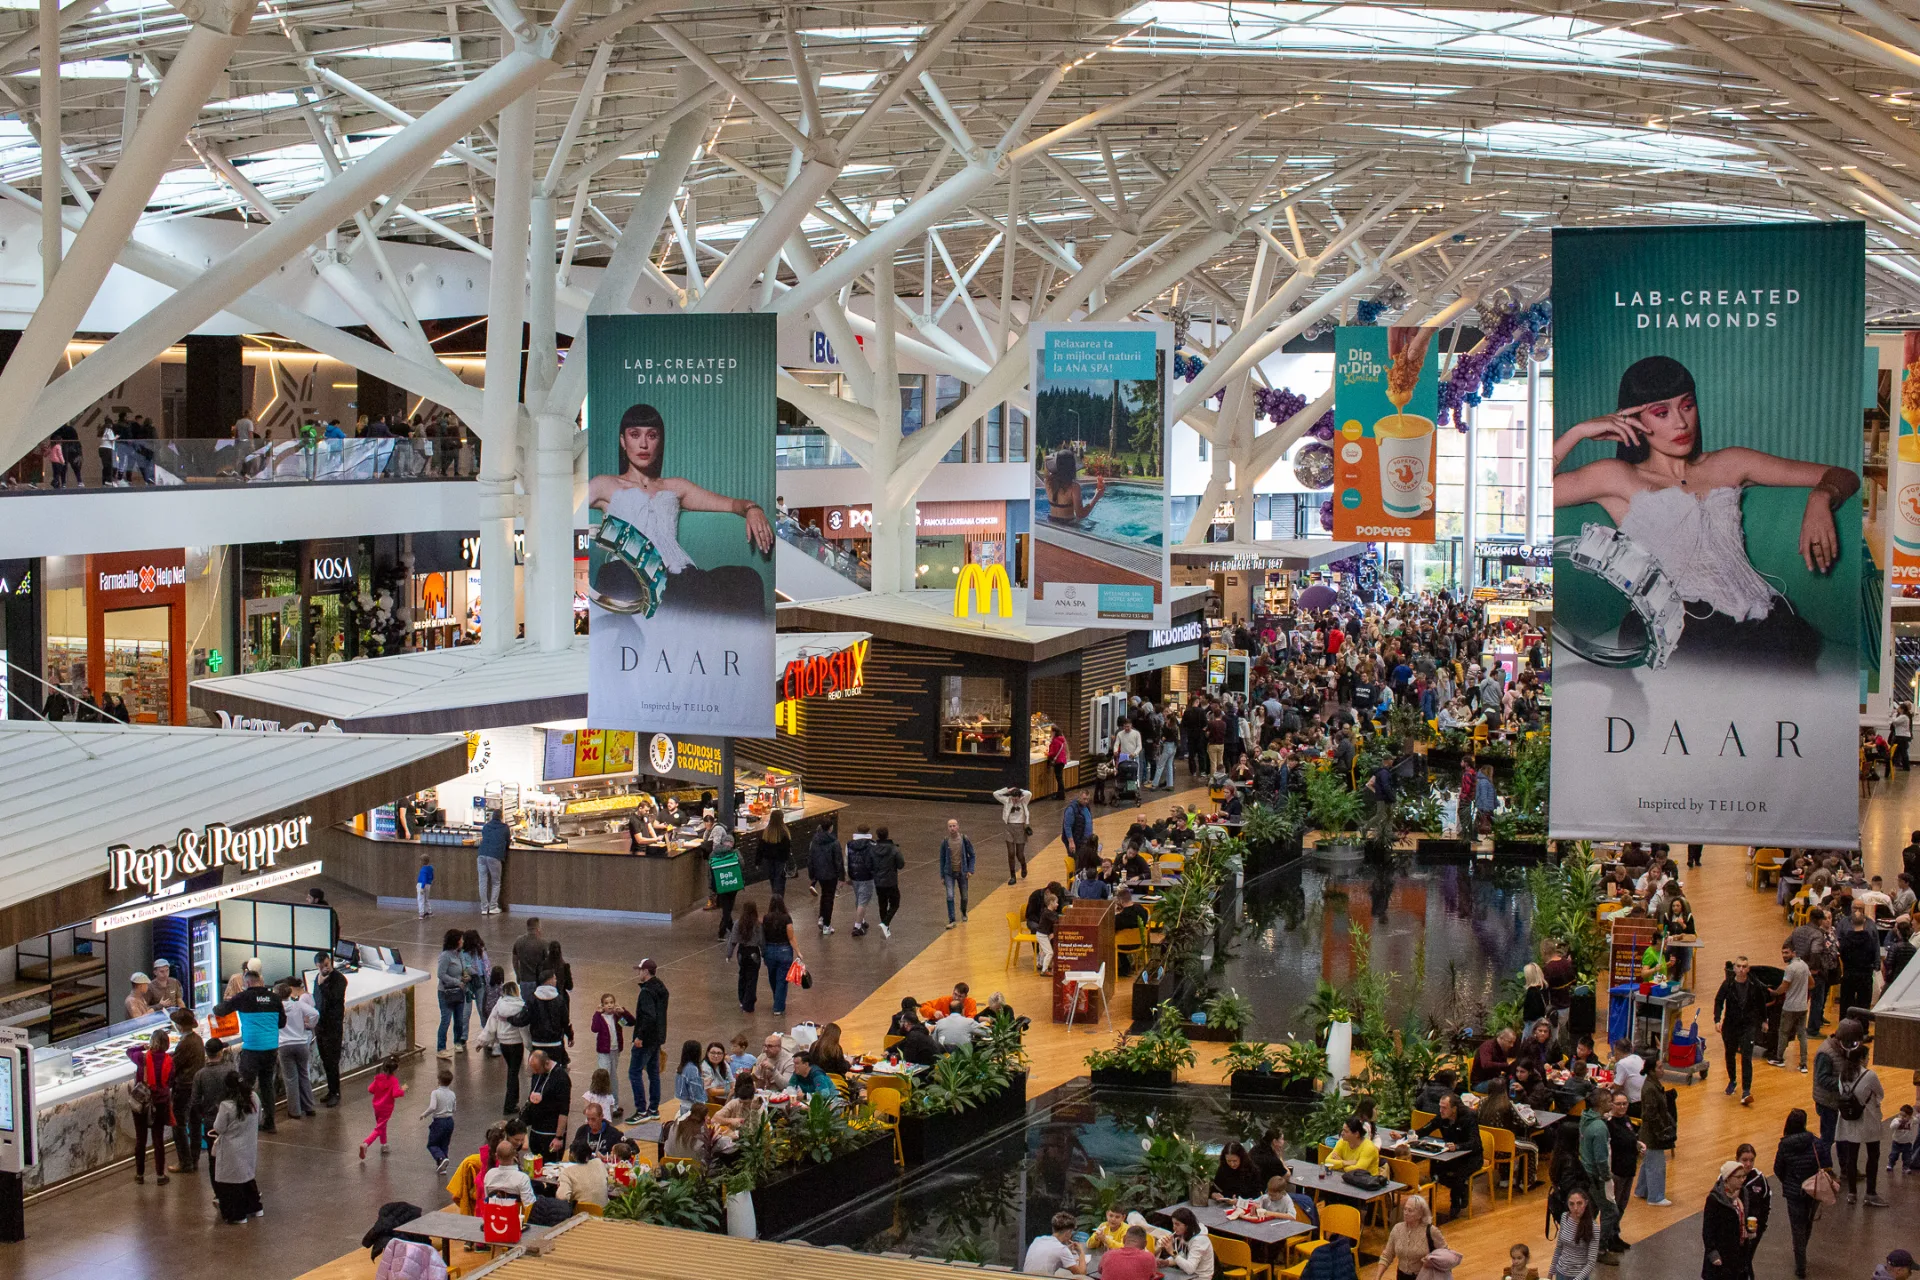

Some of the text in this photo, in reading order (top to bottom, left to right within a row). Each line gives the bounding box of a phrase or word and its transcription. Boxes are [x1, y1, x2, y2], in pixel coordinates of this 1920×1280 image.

[1614, 289, 1800, 306] LAB-CREATED
[1636, 312, 1777, 328] DIAMONDS
[1053, 339, 1113, 349] Relaxarea ta
[623, 358, 738, 370] LAB-CREATED
[1066, 351, 1106, 363] mijlocul
[1108, 351, 1142, 361] naturii
[1348, 348, 1372, 364] Dip
[1053, 363, 1113, 373] la ANA SPA!
[637, 373, 724, 385] DIAMONDS
[1477, 546, 1519, 556] TUCANO
[313, 557, 353, 580] KOSA
[99, 566, 186, 591] Farmaciile Help Net
[1055, 599, 1071, 607] ANA
[1152, 621, 1202, 648] McDonald's
[619, 646, 741, 676] DAAR
[783, 640, 869, 701] CHOPSTIX
[641, 701, 720, 713] Inspired by TEILOR
[1603, 716, 1804, 759] DAAR
[581, 746, 600, 762] XL
[1638, 797, 1768, 815] Inspired by TEILOR
[109, 814, 312, 894] Pep & Pepper
[719, 871, 733, 880] Bolt
[720, 877, 738, 887] Food
